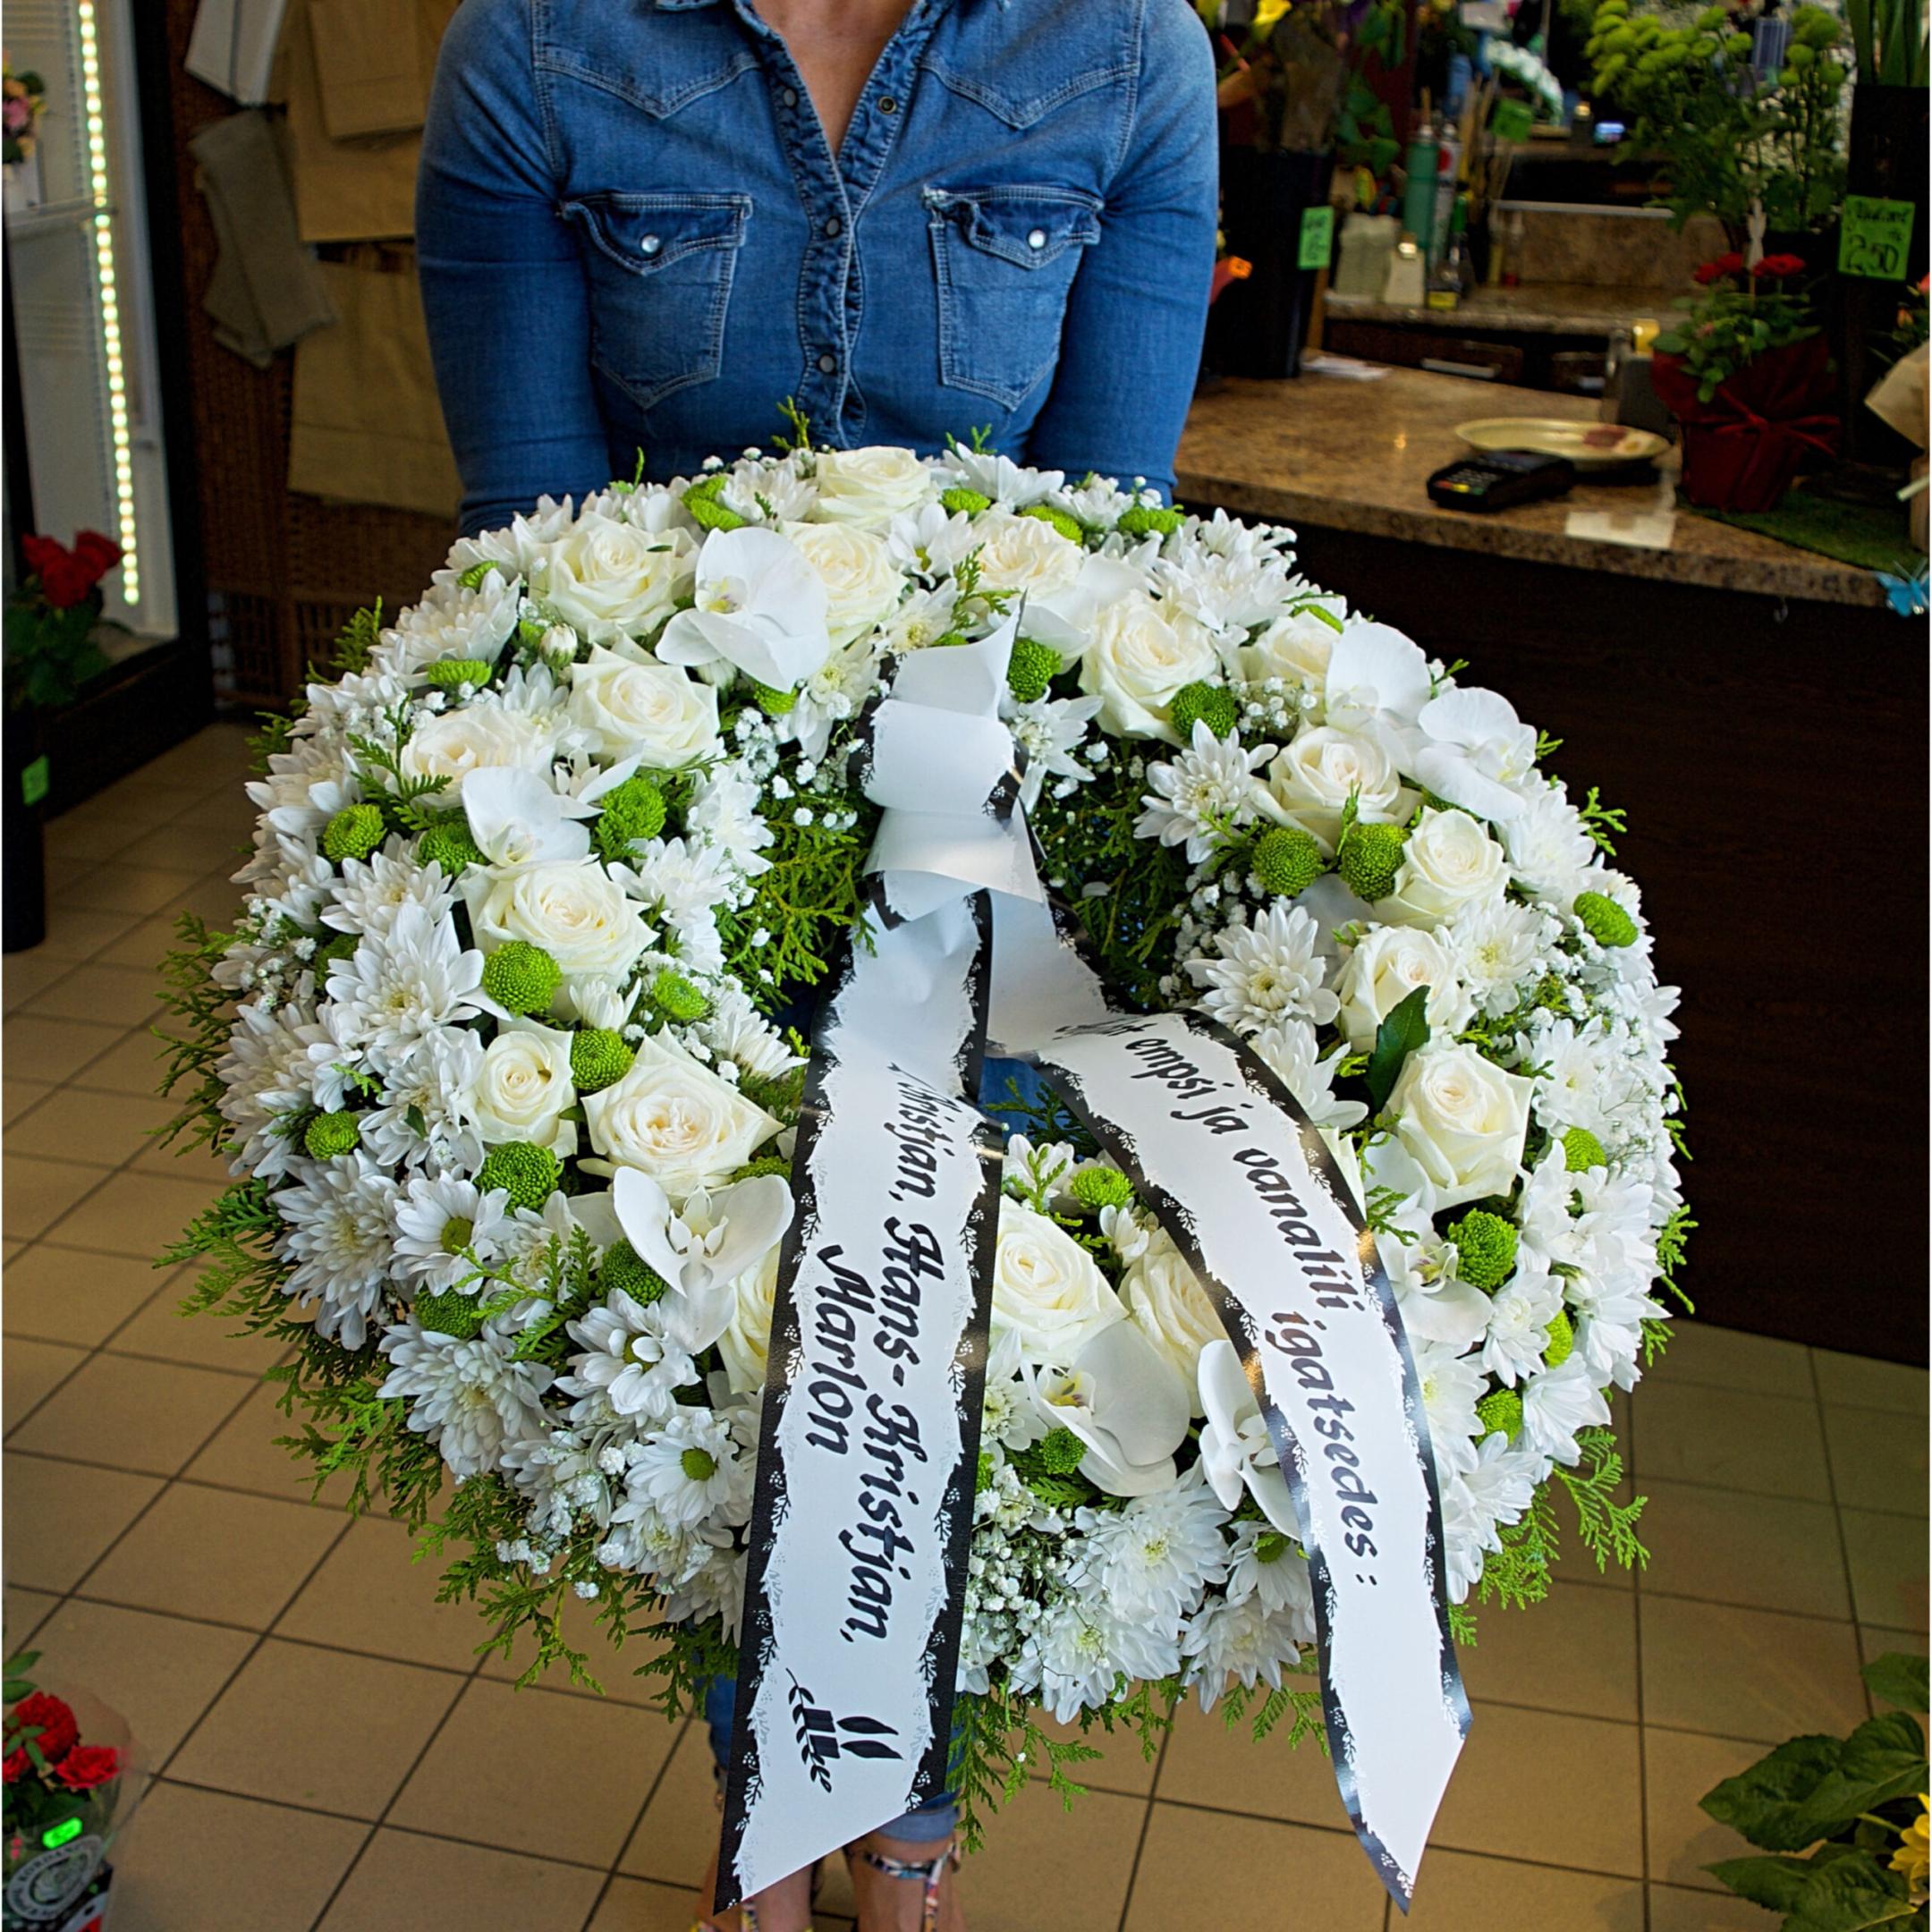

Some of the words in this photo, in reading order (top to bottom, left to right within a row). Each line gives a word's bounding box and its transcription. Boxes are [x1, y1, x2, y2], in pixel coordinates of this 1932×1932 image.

[1124, 1038, 1235, 1100] empsi
[1169, 1103, 1254, 1134] ja
[1232, 1148, 1366, 1312] vanalili
[805, 1243, 876, 1455] Marlon
[1265, 1309, 1379, 1558] igatsedes
